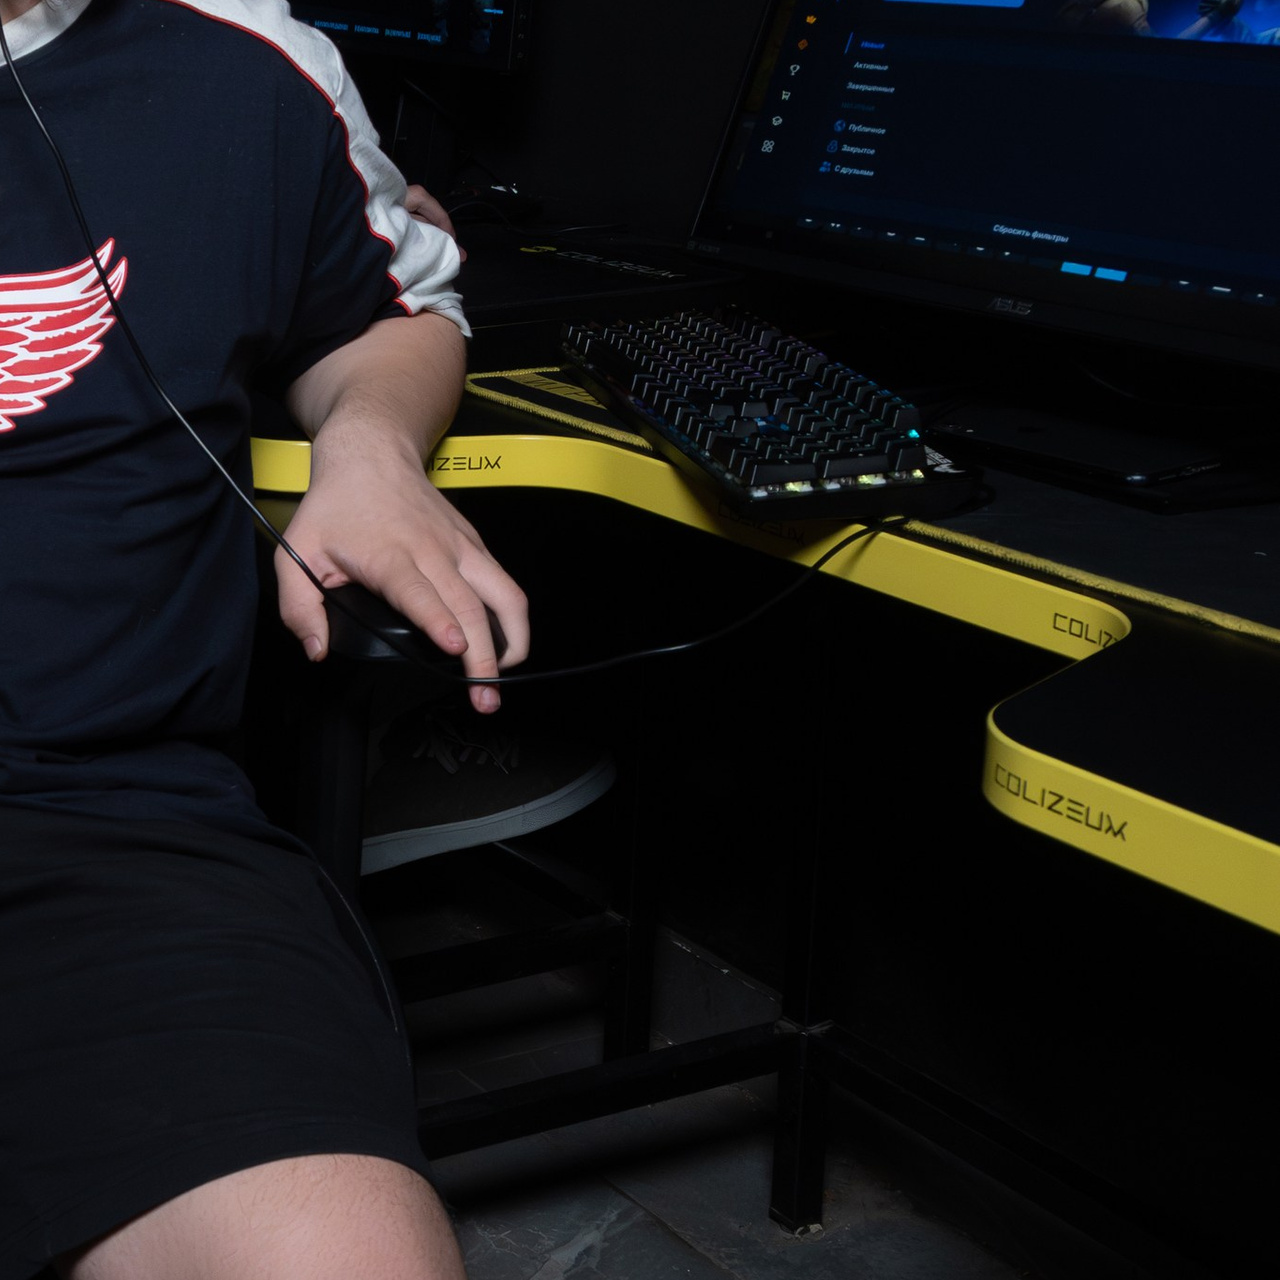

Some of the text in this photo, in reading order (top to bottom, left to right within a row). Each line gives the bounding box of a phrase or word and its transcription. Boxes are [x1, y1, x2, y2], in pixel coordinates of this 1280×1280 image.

[853, 61, 889, 71] Активные
[992, 224, 1070, 243] Сбросить фильтры
[1053, 613, 1118, 648] COLIZ
[994, 763, 1127, 842] COLIZEUM
